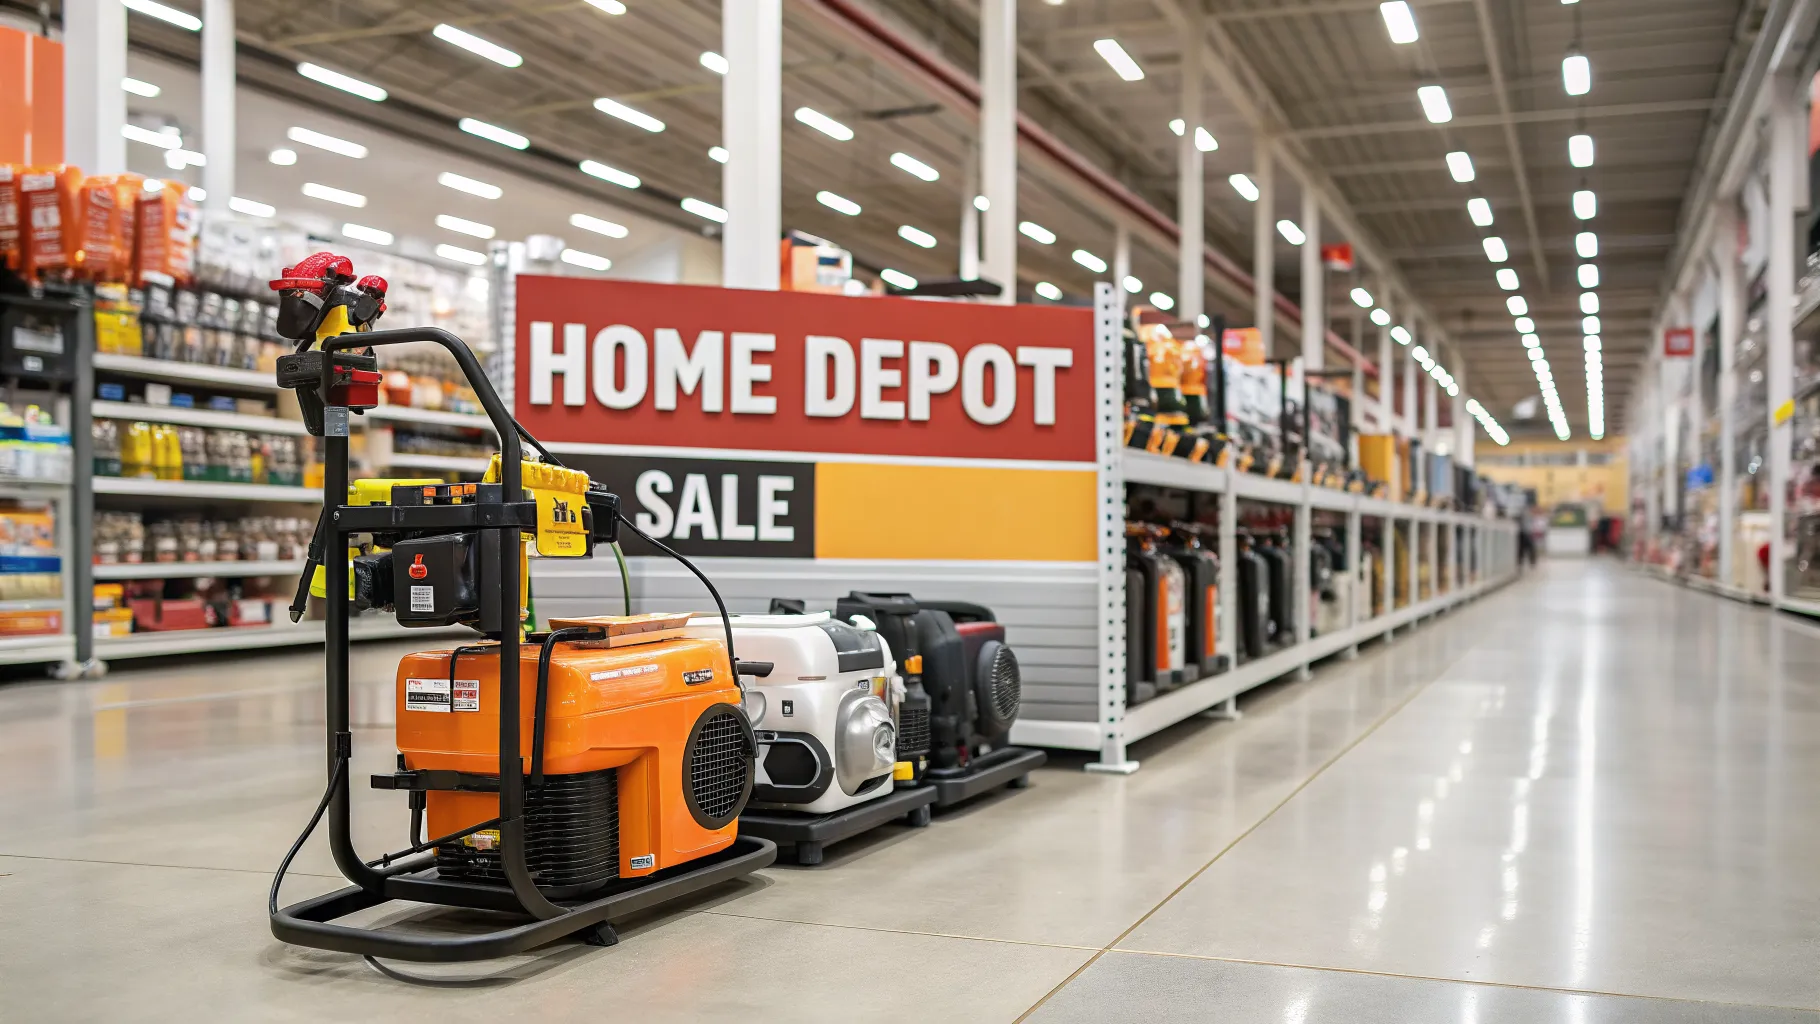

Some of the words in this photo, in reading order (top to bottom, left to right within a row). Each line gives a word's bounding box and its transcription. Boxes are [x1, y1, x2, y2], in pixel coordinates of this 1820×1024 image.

[529, 321, 777, 414] HOME
[804, 335, 1073, 426] DEPOT
[635, 469, 795, 541] SALE
